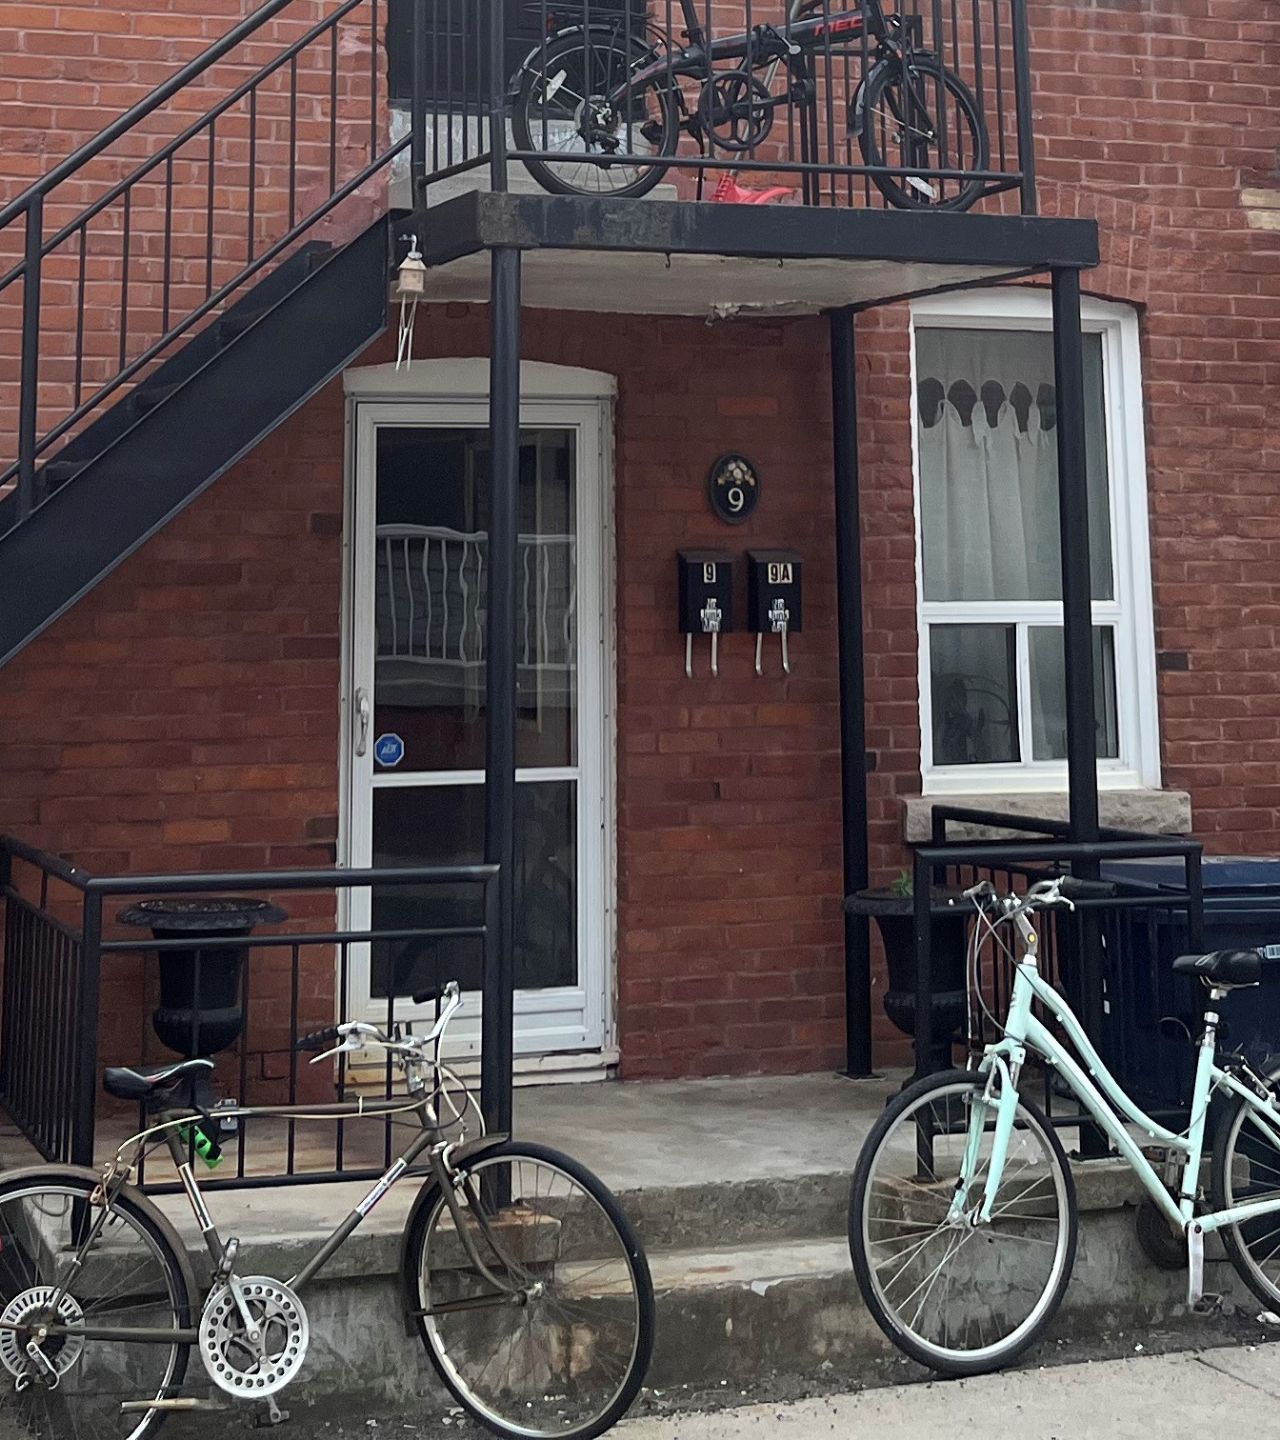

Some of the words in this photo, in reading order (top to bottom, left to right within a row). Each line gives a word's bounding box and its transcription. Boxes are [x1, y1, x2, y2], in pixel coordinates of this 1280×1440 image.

[728, 487, 744, 512] 9
[705, 563, 714, 581] 9
[770, 564, 791, 582] 9A
